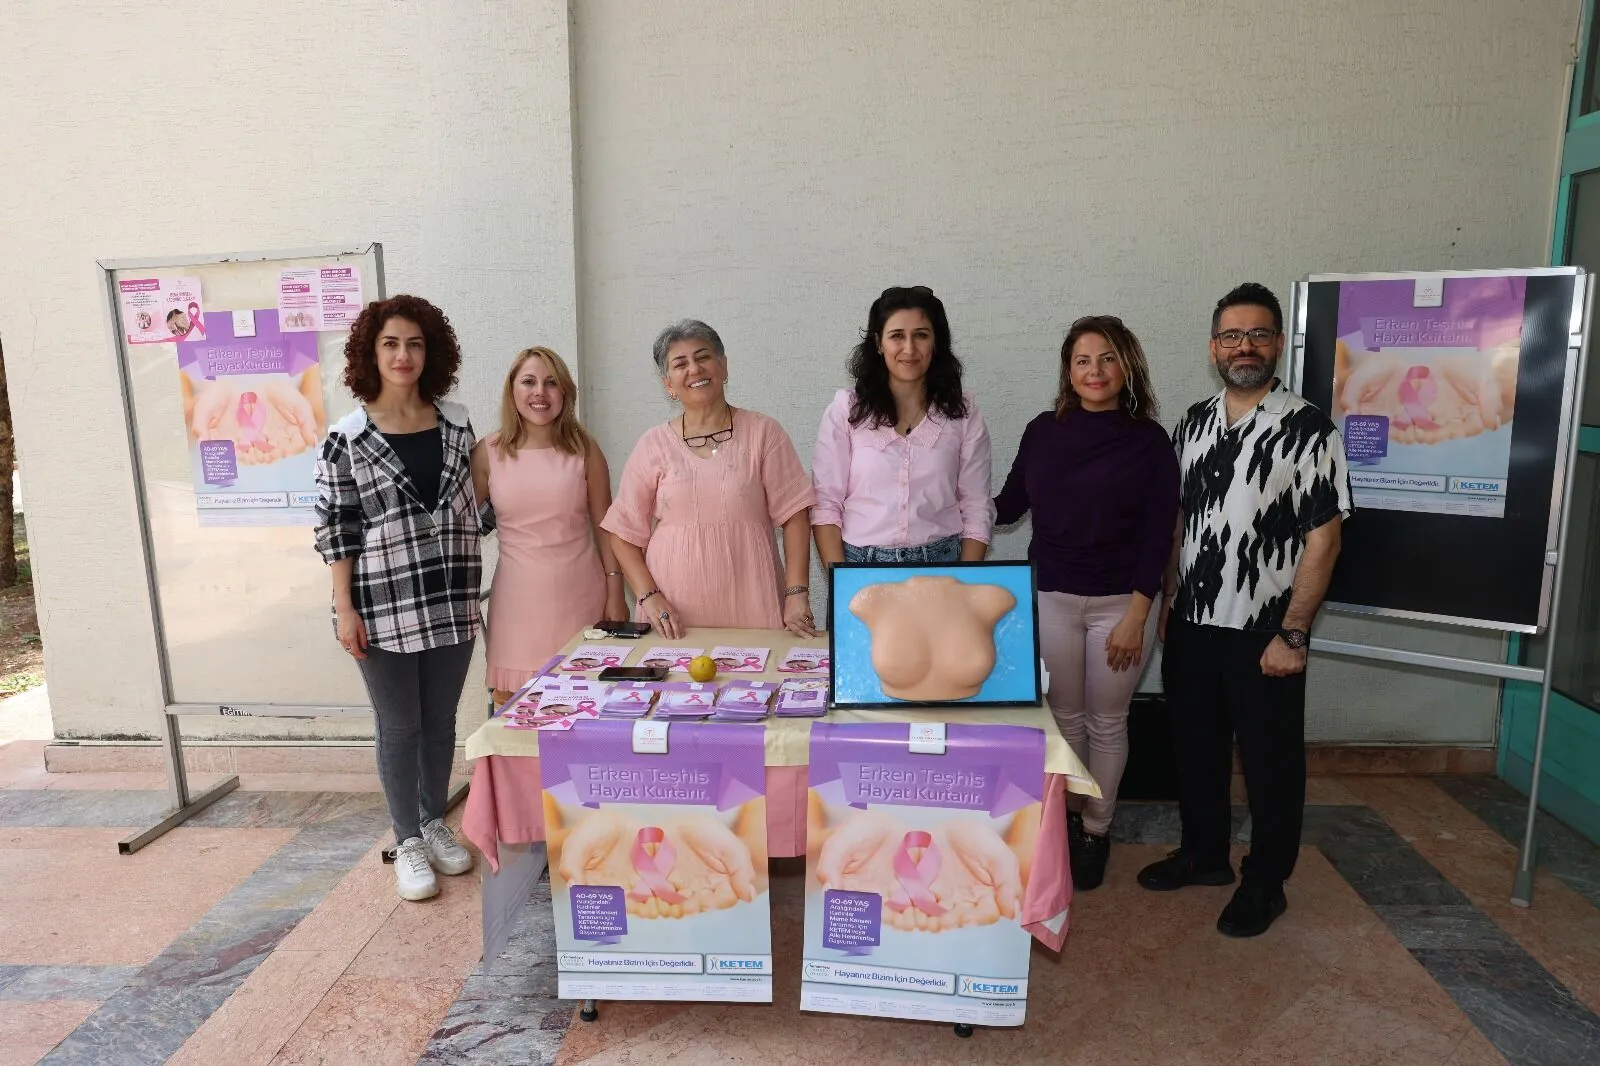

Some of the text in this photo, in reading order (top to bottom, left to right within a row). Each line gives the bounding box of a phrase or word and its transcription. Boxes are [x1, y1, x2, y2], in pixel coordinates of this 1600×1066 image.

[1375, 319, 1419, 331] Erken
[1374, 331, 1413, 345] Hayat
[207, 348, 242, 360] Erken
[208, 360, 240, 374] Hayat
[1460, 482, 1499, 491] KETEM
[588, 765, 709, 788] Erken Teşhis
[858, 765, 985, 788] Erken Teşhis
[589, 784, 710, 801] Hayat Kurtarır.
[858, 782, 984, 805] Hayat Kurtarır.
[854, 899, 870, 908] YAŞ
[588, 958, 623, 968] Hayatınız
[624, 959, 645, 967] Bizim
[719, 960, 763, 968] KETEM
[834, 969, 871, 981] Hayatınız
[871, 973, 894, 983] Bizim
[894, 974, 908, 985] İçin
[973, 982, 1018, 993] KETEM
